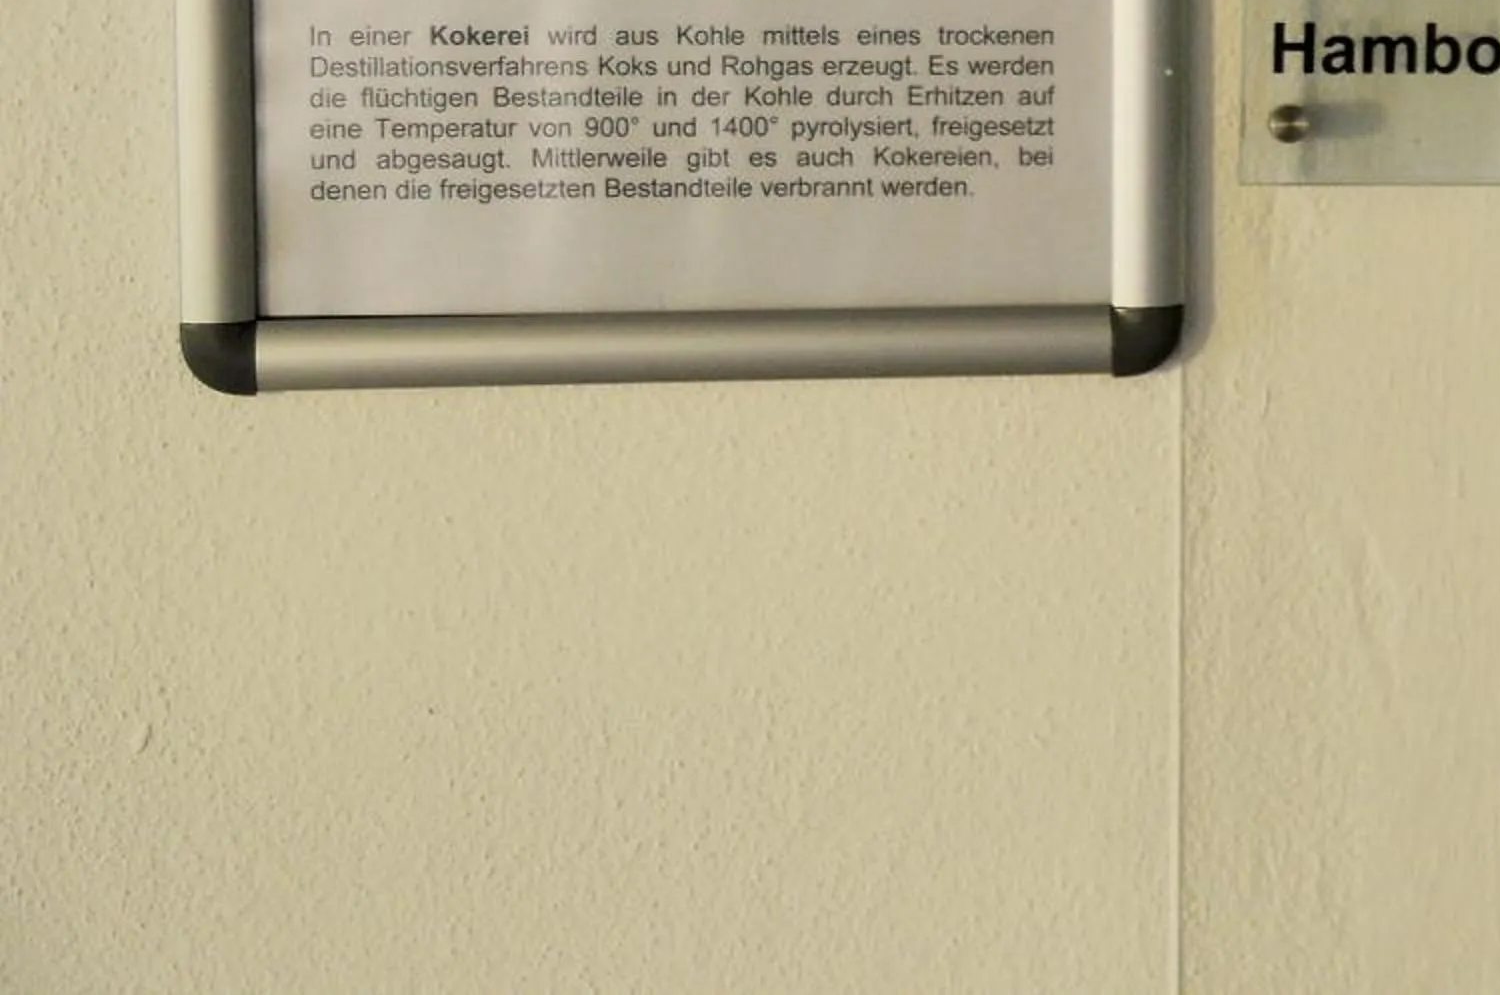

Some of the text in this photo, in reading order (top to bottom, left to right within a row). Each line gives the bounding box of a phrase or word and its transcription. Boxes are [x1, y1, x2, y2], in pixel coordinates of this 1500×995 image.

[310, 25, 1054, 46] In einer Kokerei wird aus Kohle mittels eines trockenen
[310, 55, 1054, 80] Destillationsverfahrens Koks und Rohgas erzeugt. Es werden
[310, 85, 1055, 112] die flüchtigen Bestandteile in der Kohle durch Erhitzen auf
[310, 115, 1054, 142] eine Temperatur von 900° und 1400° pyrolysiert, freigesetzt
[310, 147, 1054, 174] und abgesaugt. Mittlerweile gibt es auch Kokereien, bei
[310, 178, 974, 203] denen die freigesetzten Bestandteile verbrannt werden.
